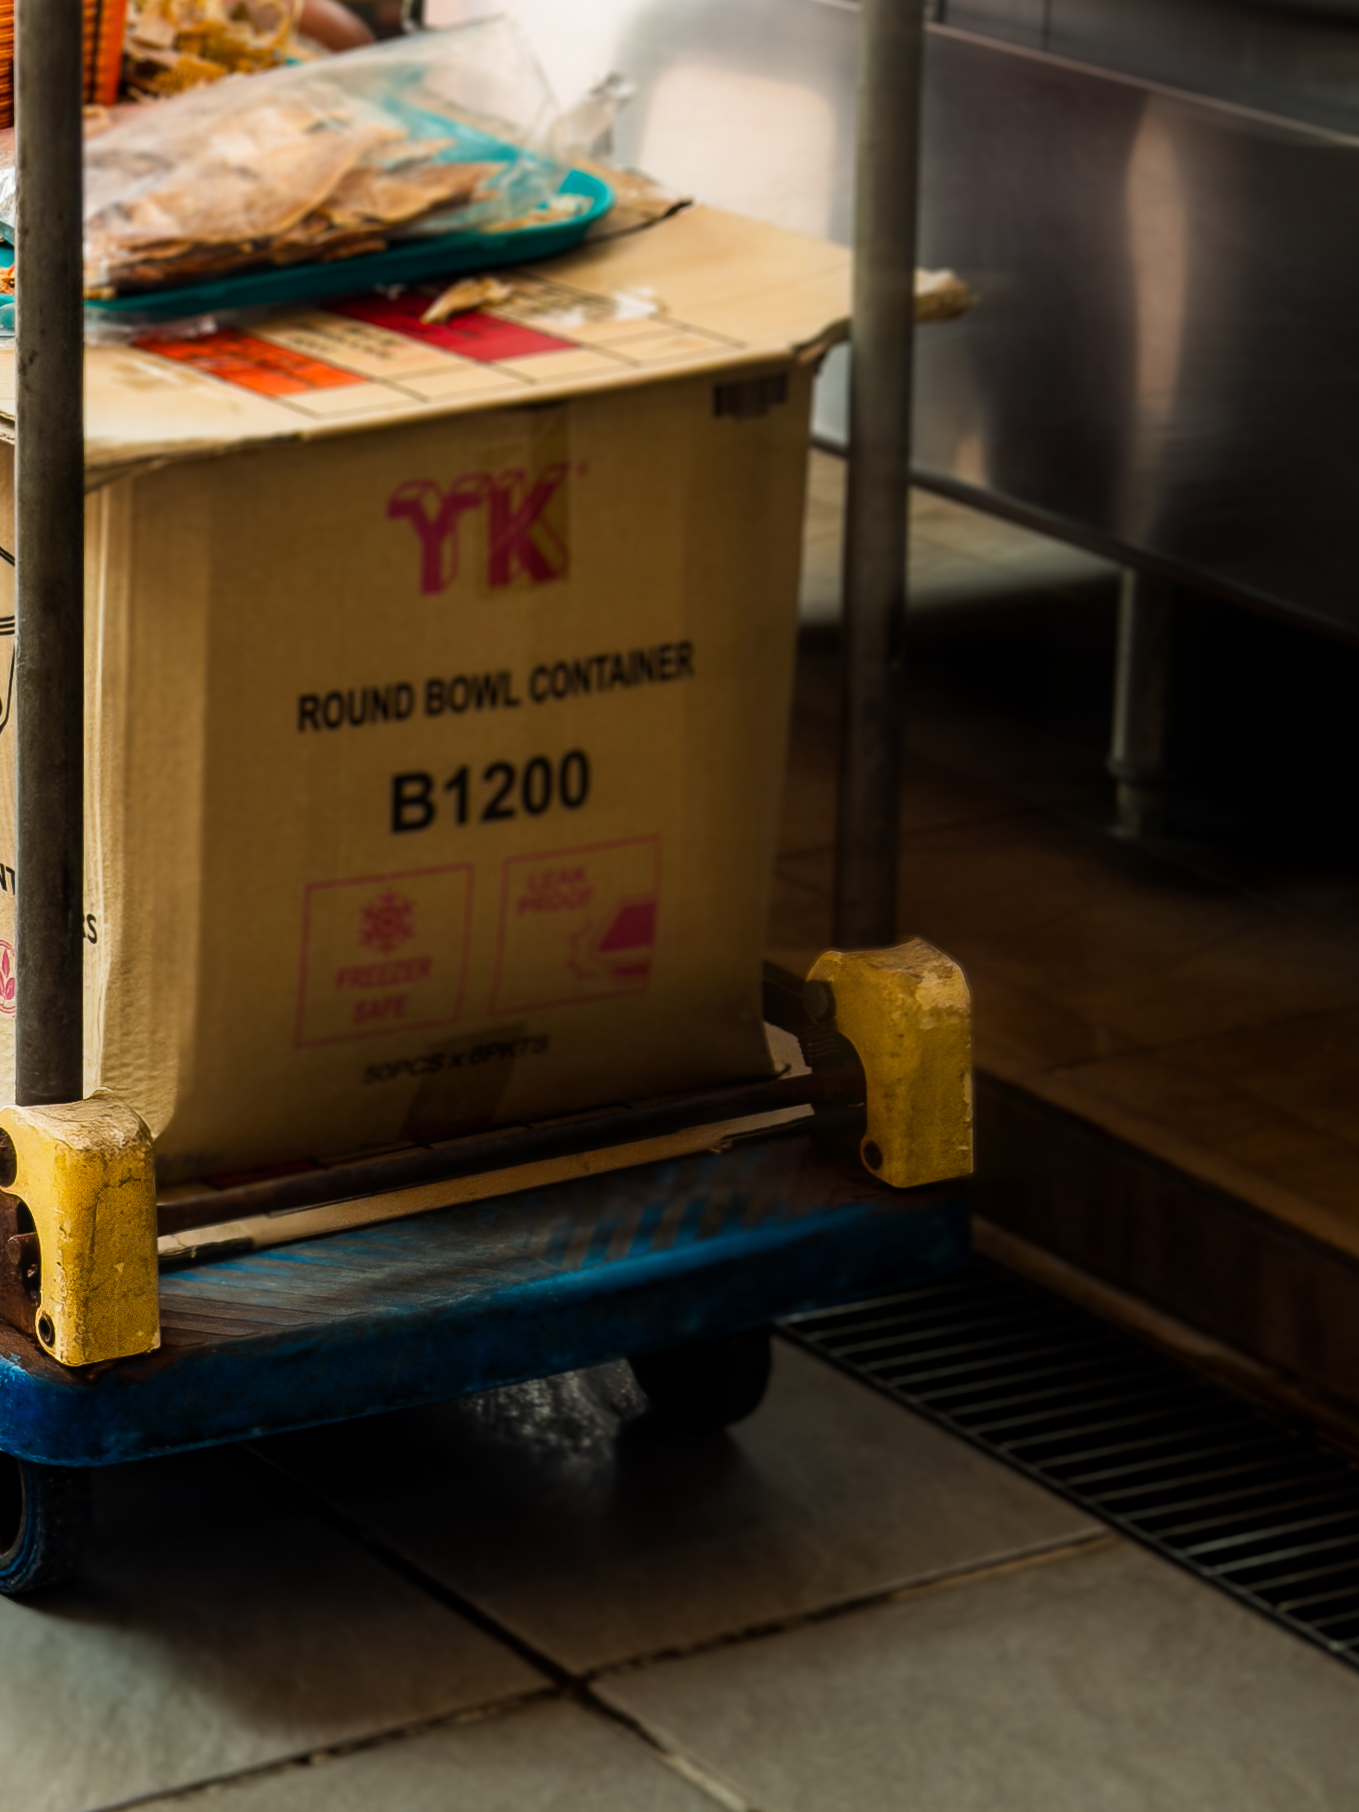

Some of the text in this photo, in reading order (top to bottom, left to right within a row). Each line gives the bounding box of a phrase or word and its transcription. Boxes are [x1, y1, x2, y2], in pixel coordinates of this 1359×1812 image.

[387, 463, 570, 595] YK
[298, 641, 695, 733] ROUND BOWL CONTAINER
[390, 751, 590, 835] B1200
[528, 866, 588, 891] LEAK
[517, 887, 592, 916] PROOF
[335, 957, 432, 992] FREEZER
[354, 994, 409, 1023] SAFE
